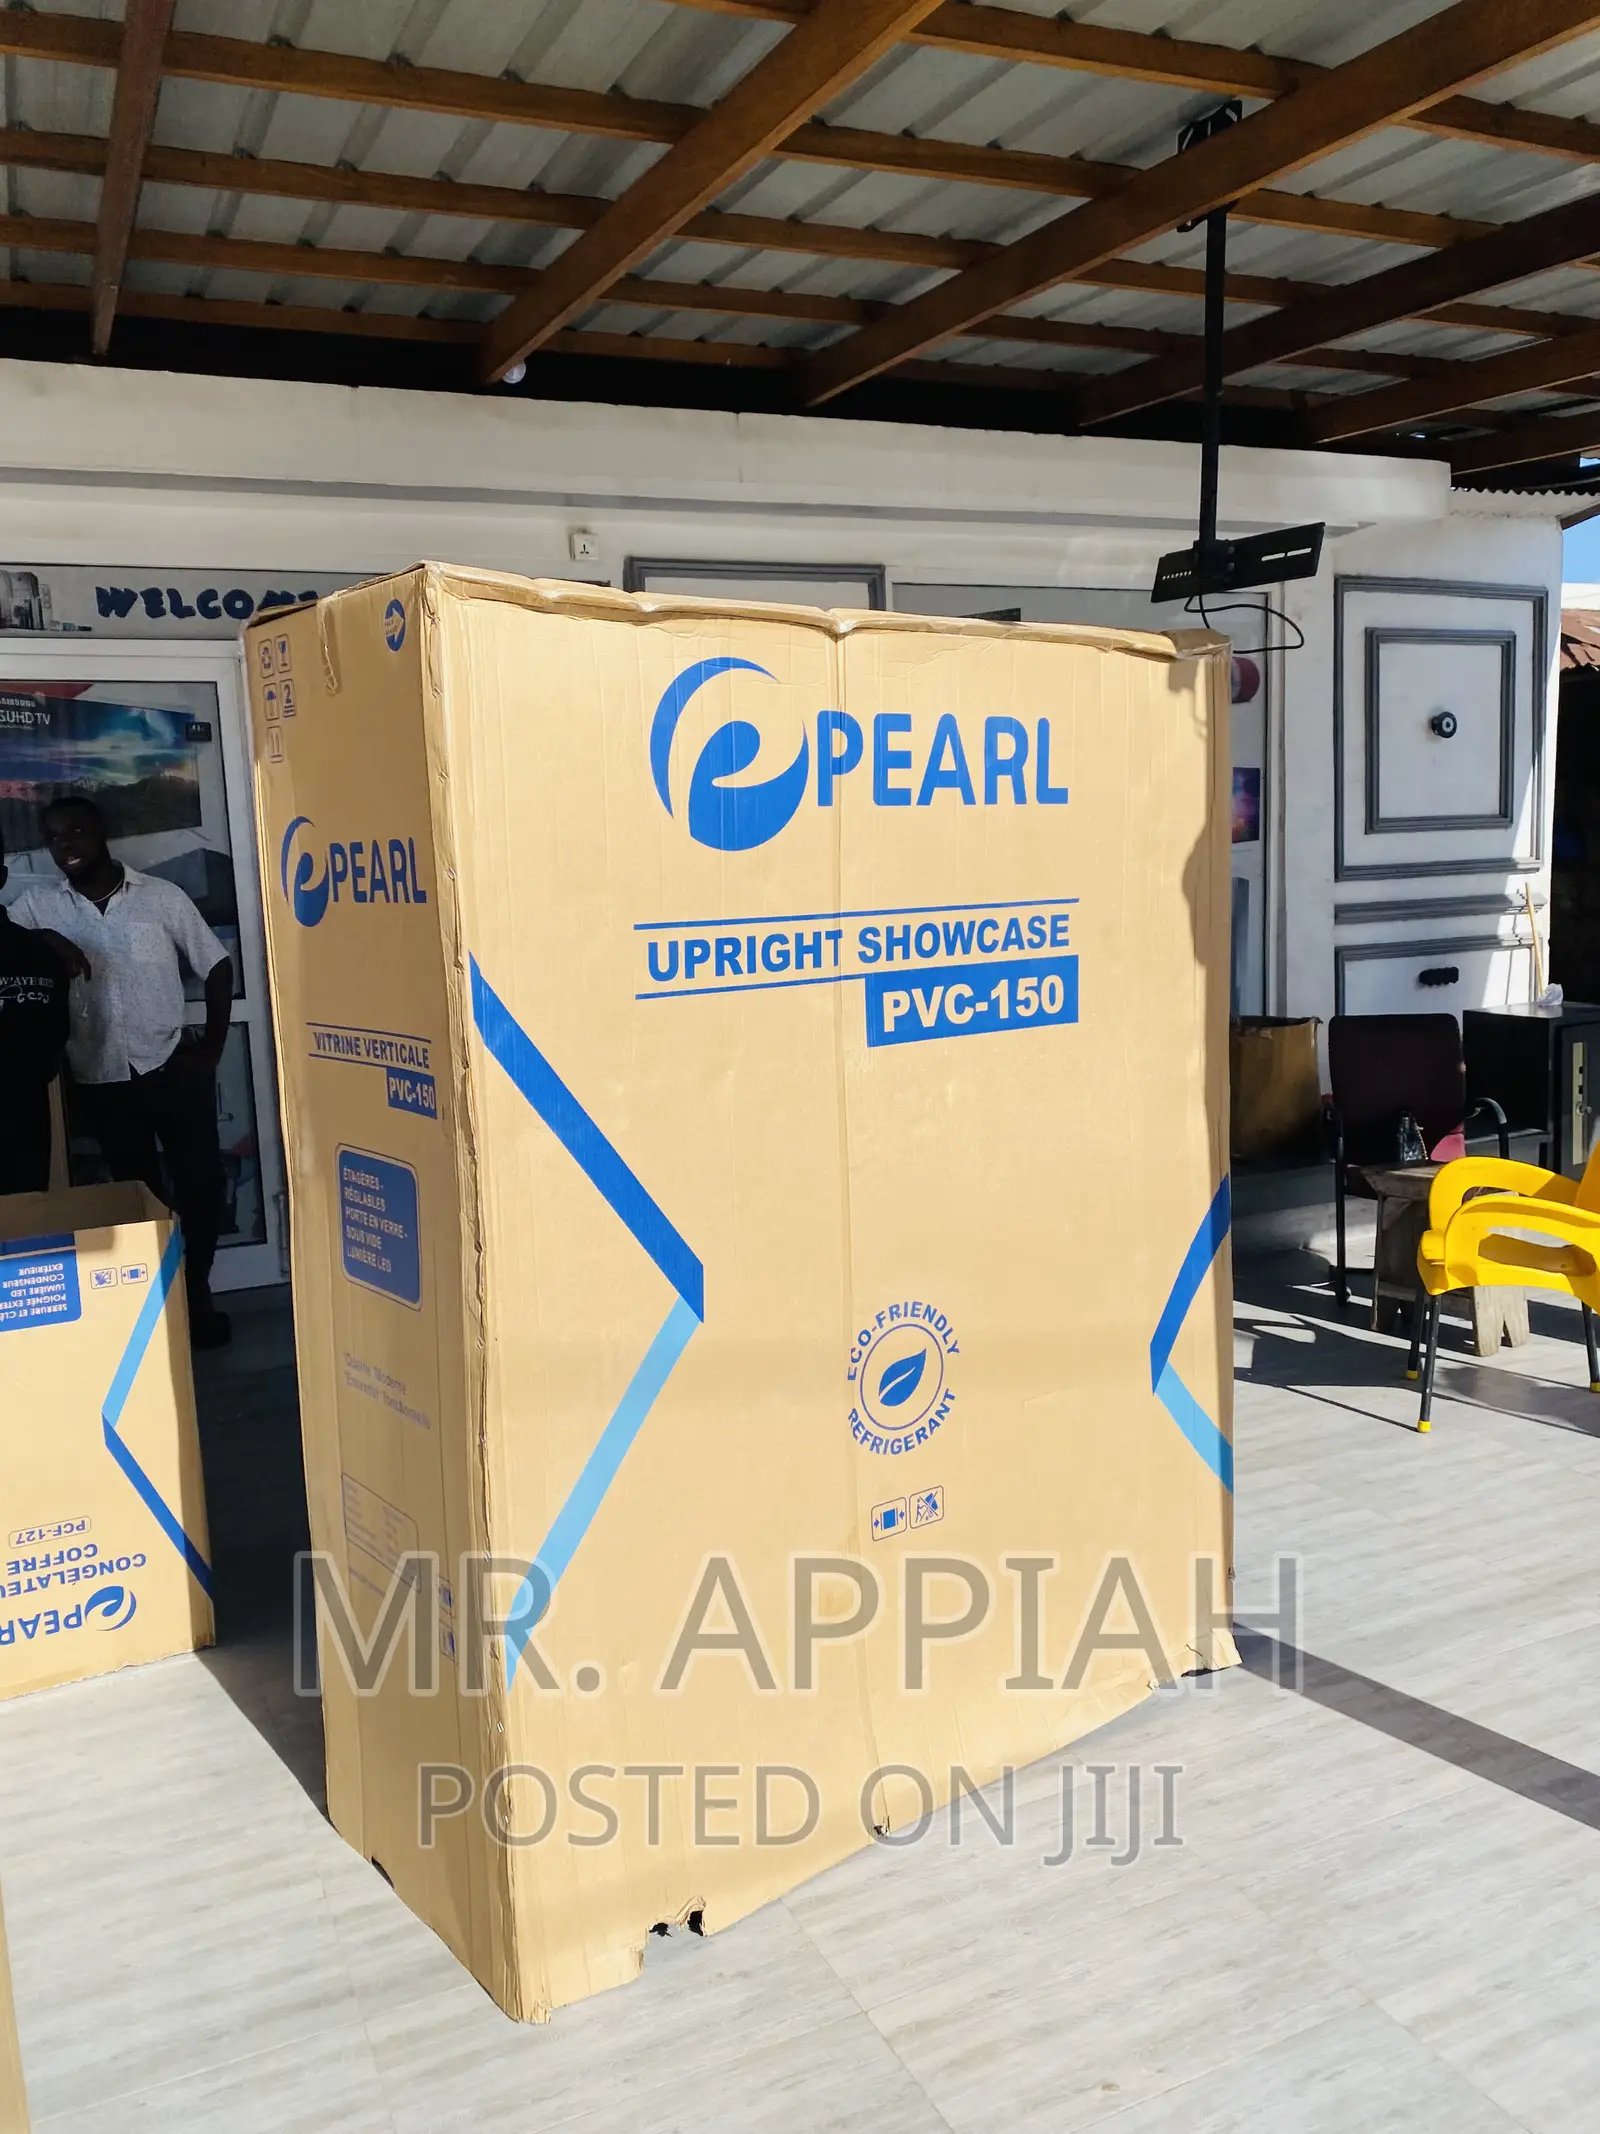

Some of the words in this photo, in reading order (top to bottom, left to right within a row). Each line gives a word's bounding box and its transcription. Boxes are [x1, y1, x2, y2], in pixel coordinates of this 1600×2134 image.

[817, 710, 1069, 807] PEARL
[328, 836, 427, 904] PEARL
[648, 929, 843, 982] UPRIGHT
[858, 914, 1070, 964] SHOWCASE
[883, 974, 1064, 1033] PVC-150
[313, 1032, 360, 1056] VITRINE
[363, 1037, 430, 1069] VERTICALE
[388, 1077, 435, 1110] PVC-150
[377, 1255, 392, 1272] LED
[3, 1273, 64, 1288] CONDENSEUR
[11, 1289, 26, 1297] LED
[26, 1294, 66, 1306] POIGNÉE
[31, 1304, 67, 1315] SERRURE
[847, 1301, 960, 1381] ECO-FRIENDLY
[847, 1388, 956, 1456] REFRIGERANT
[15, 1520, 86, 1545] PCF-127
[6, 1543, 98, 1576] COFFRE
